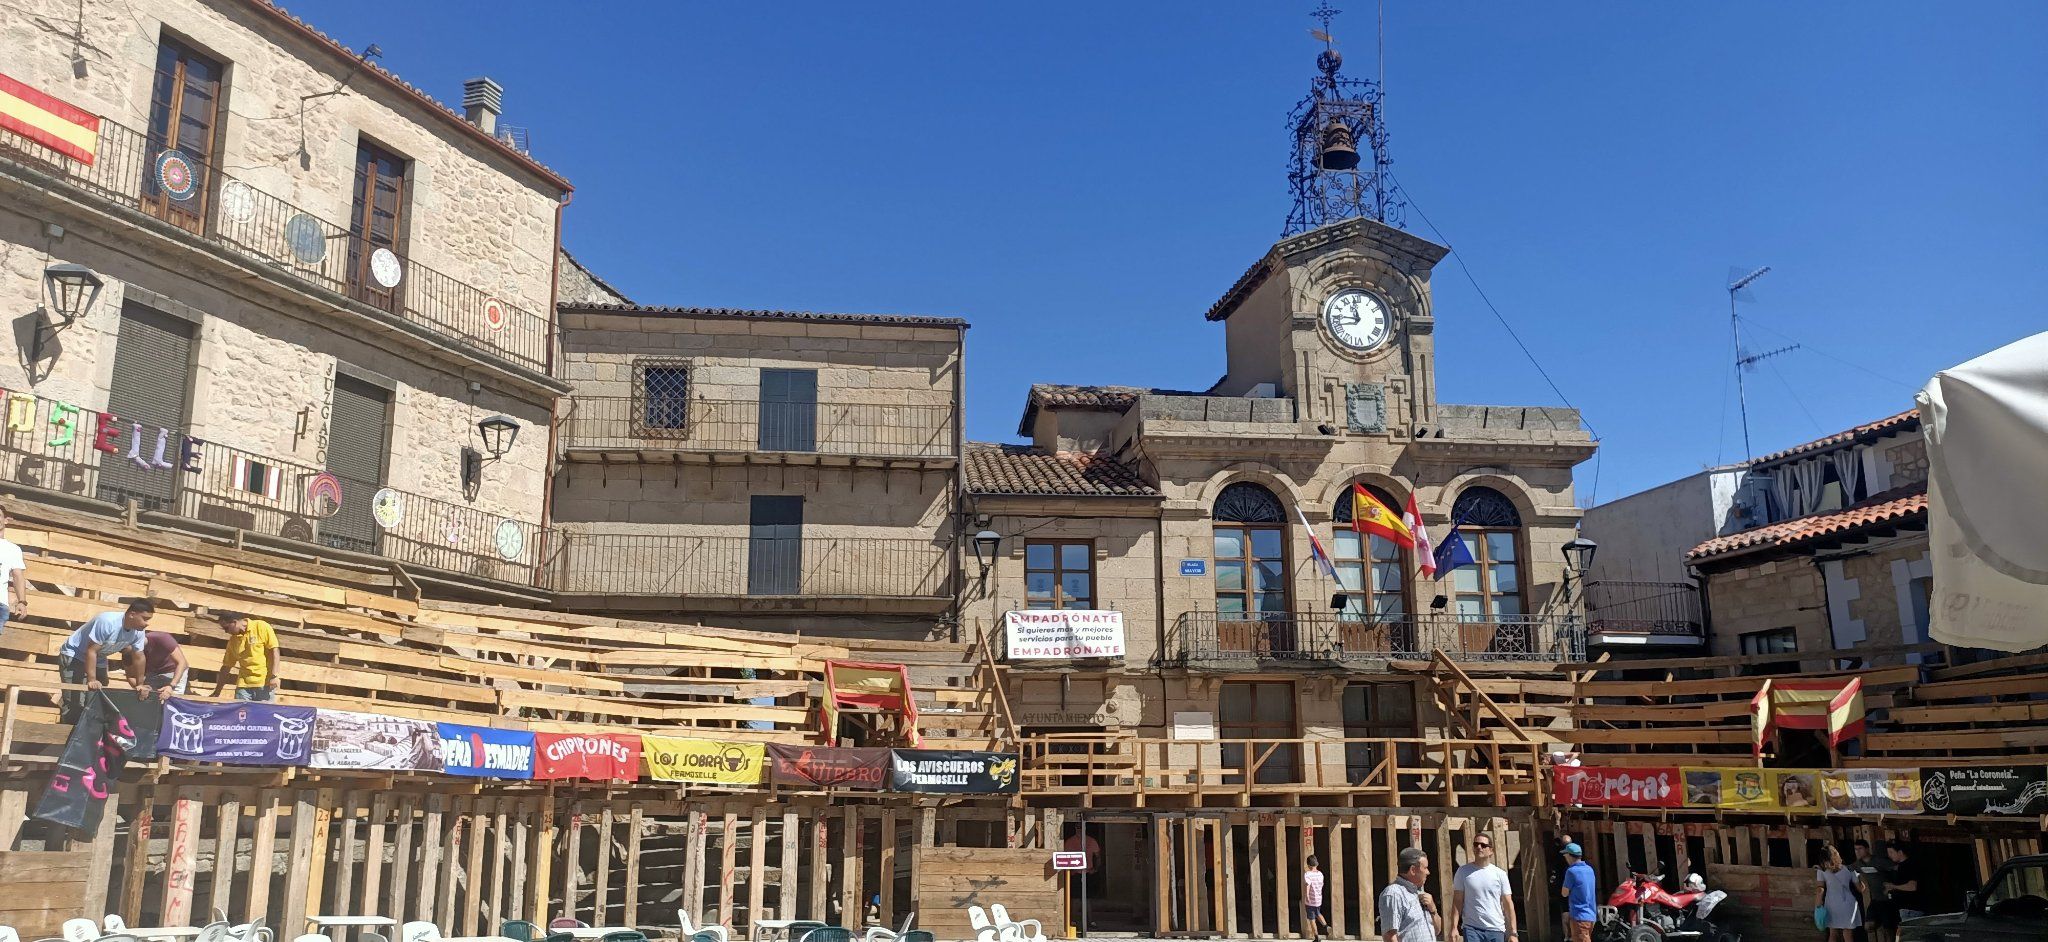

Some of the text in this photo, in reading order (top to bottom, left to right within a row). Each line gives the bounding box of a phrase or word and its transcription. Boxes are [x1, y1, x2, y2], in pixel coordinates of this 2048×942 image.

[316, 362, 335, 464] JUZGADO
[0, 388, 205, 475] OSELLE
[1011, 613, 1118, 624] EMPADRÓNATE
[1026, 627, 1056, 635] quieres
[1055, 634, 1074, 643] para
[1013, 644, 1120, 656] EMPADRÓNATE
[1020, 711, 1105, 723] AYUNTAMIENTO
[440, 733, 532, 771] PEÑA DESMADRE
[547, 737, 631, 763] CHIPIRONES
[896, 760, 985, 774] LOS AVISCUEROS
[670, 769, 718, 779] FERMOSELLE
[911, 774, 968, 785] FERMOSELLE
[1949, 769, 1966, 780] Peña
